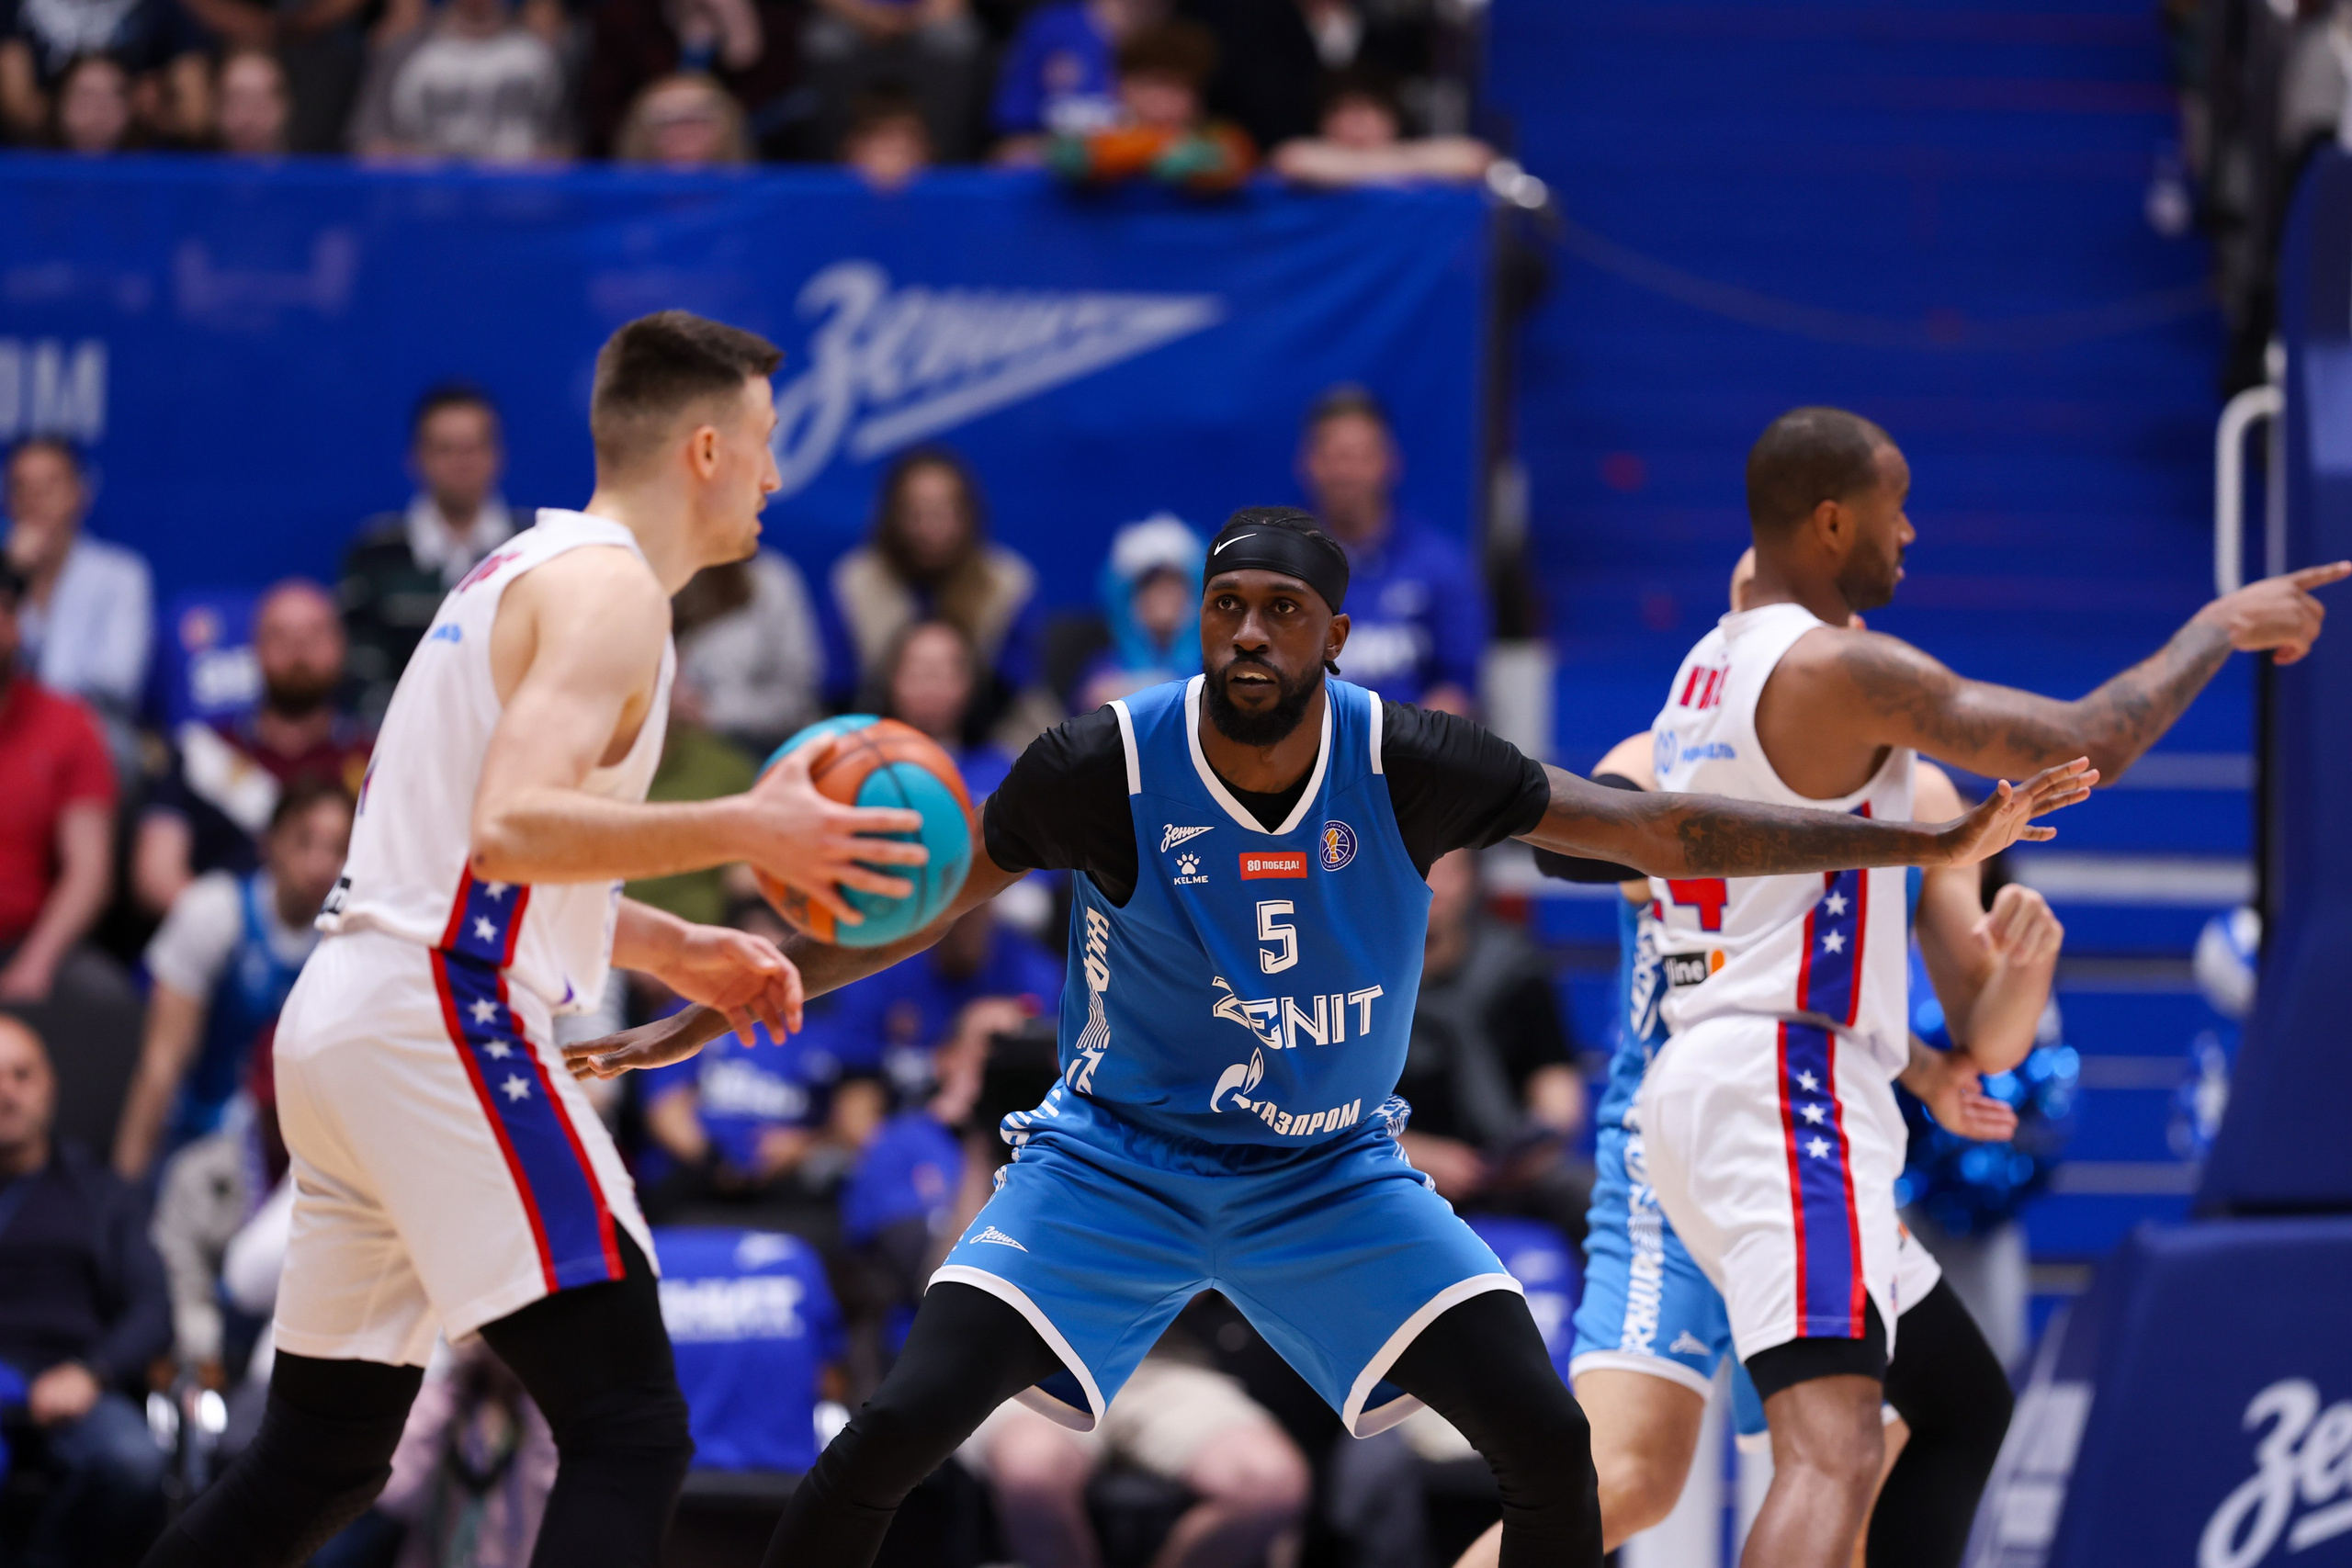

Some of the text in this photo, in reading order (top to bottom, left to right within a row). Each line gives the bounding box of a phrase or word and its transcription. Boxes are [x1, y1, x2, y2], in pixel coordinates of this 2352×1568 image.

[1173, 874, 1209, 886] KELME
[1247, 859, 1300, 872] 80 ПОБЕДА!
[1256, 899, 1298, 974] 5
[1212, 976, 1384, 1050] ZENIT
